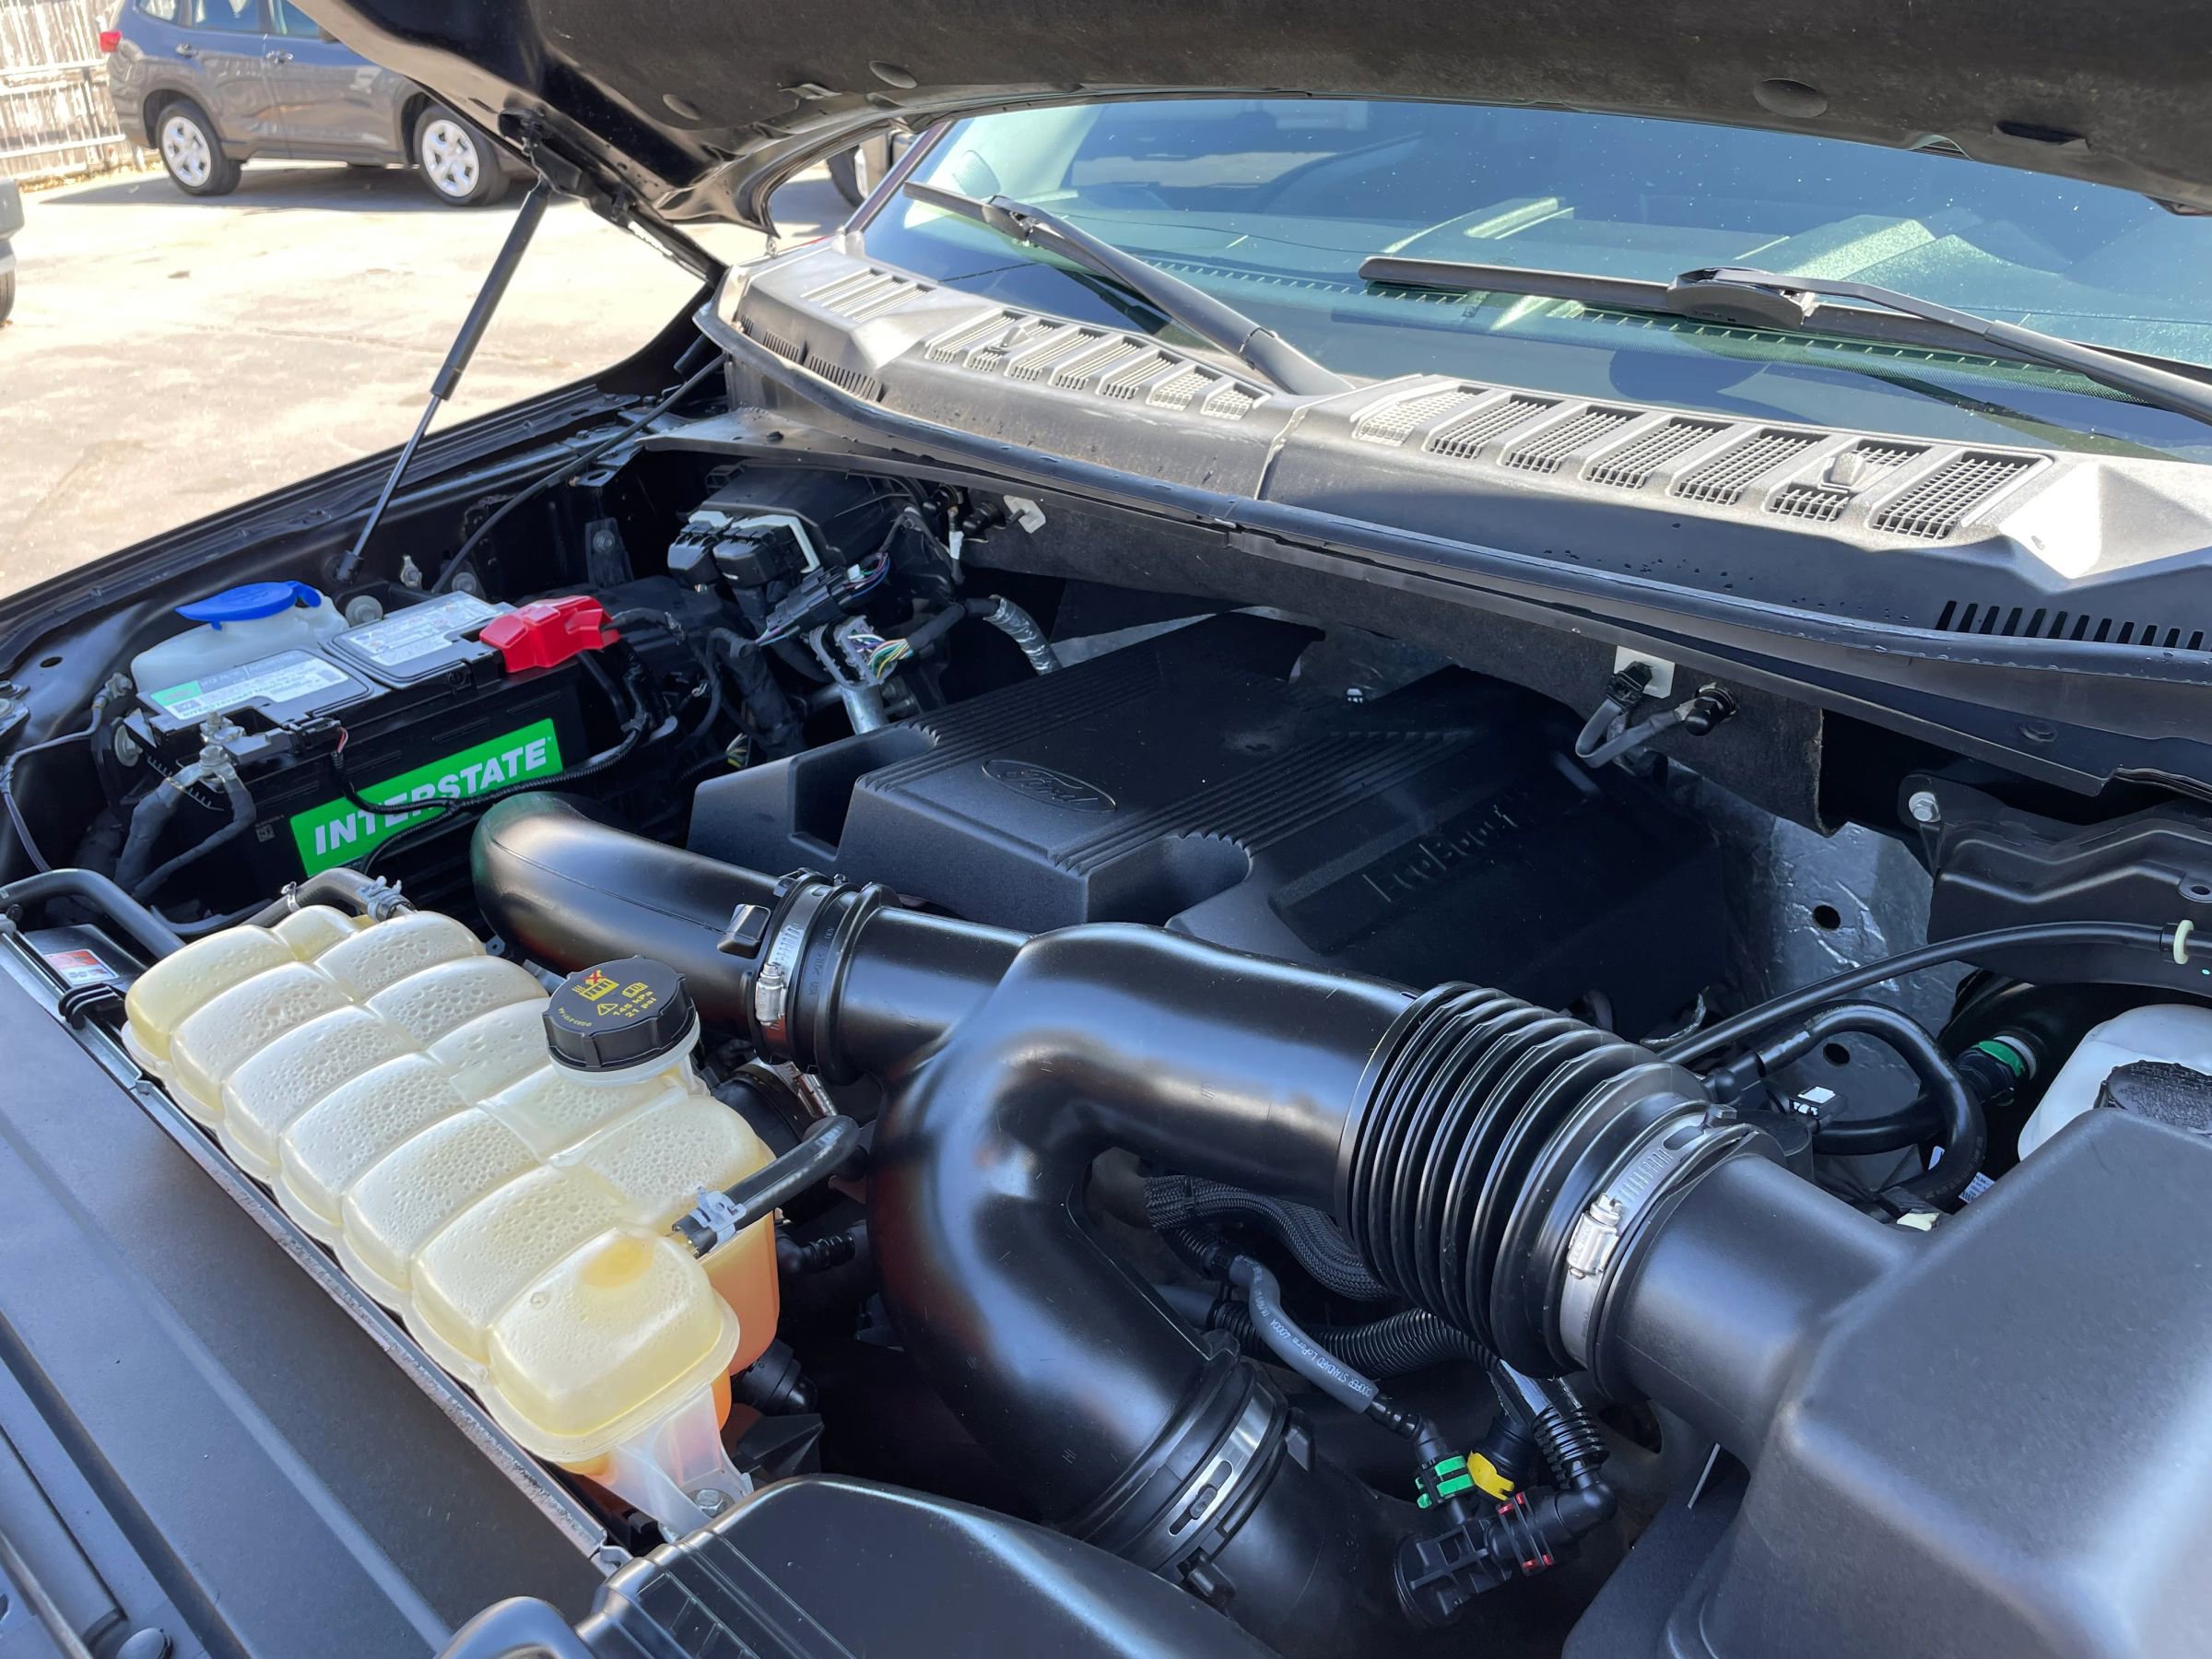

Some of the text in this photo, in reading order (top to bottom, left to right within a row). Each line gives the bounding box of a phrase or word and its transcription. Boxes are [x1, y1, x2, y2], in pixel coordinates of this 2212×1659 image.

[315, 738, 547, 855] INTERSTATE
[994, 767, 1101, 806] Ford
[1316, 1357, 1349, 1382] STANDARD
[1347, 1377, 1372, 1397] COOPER
